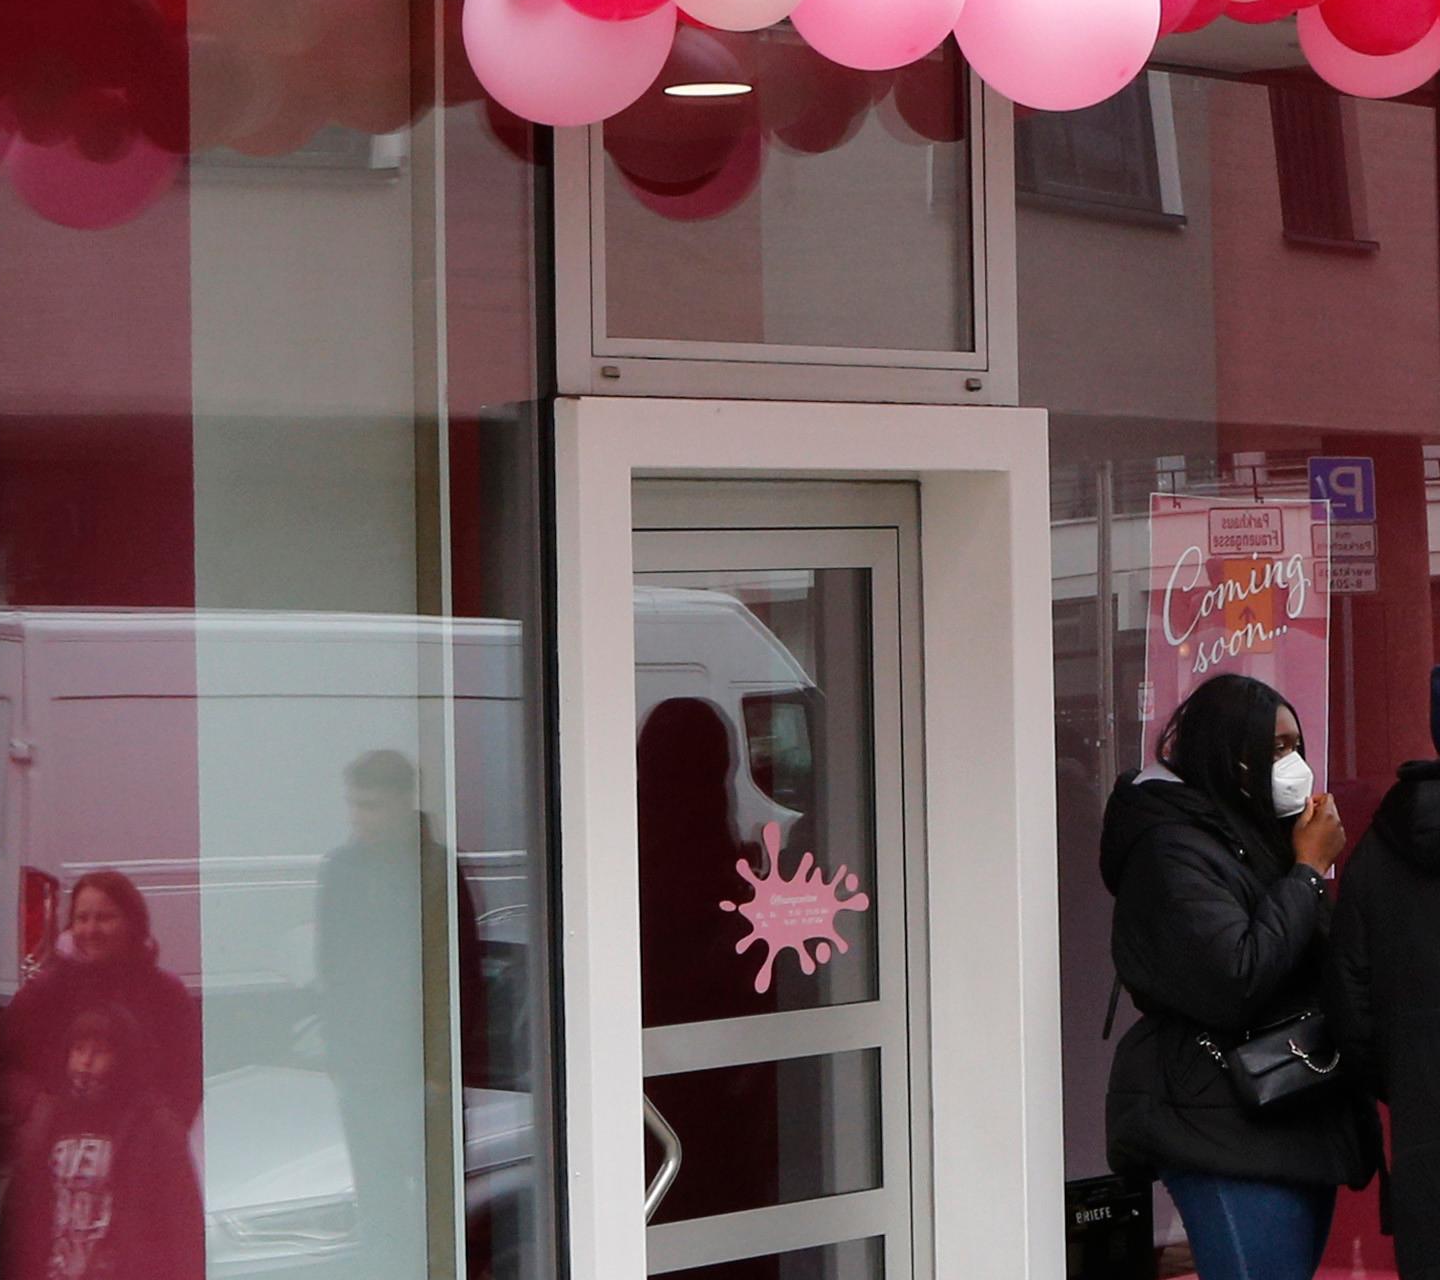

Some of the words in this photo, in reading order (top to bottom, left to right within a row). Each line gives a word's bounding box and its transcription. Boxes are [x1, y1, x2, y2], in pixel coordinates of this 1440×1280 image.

[1163, 546, 1311, 646] Coming
[1192, 621, 1289, 673] soon...
[1075, 1206, 1112, 1224] BRIEFE
